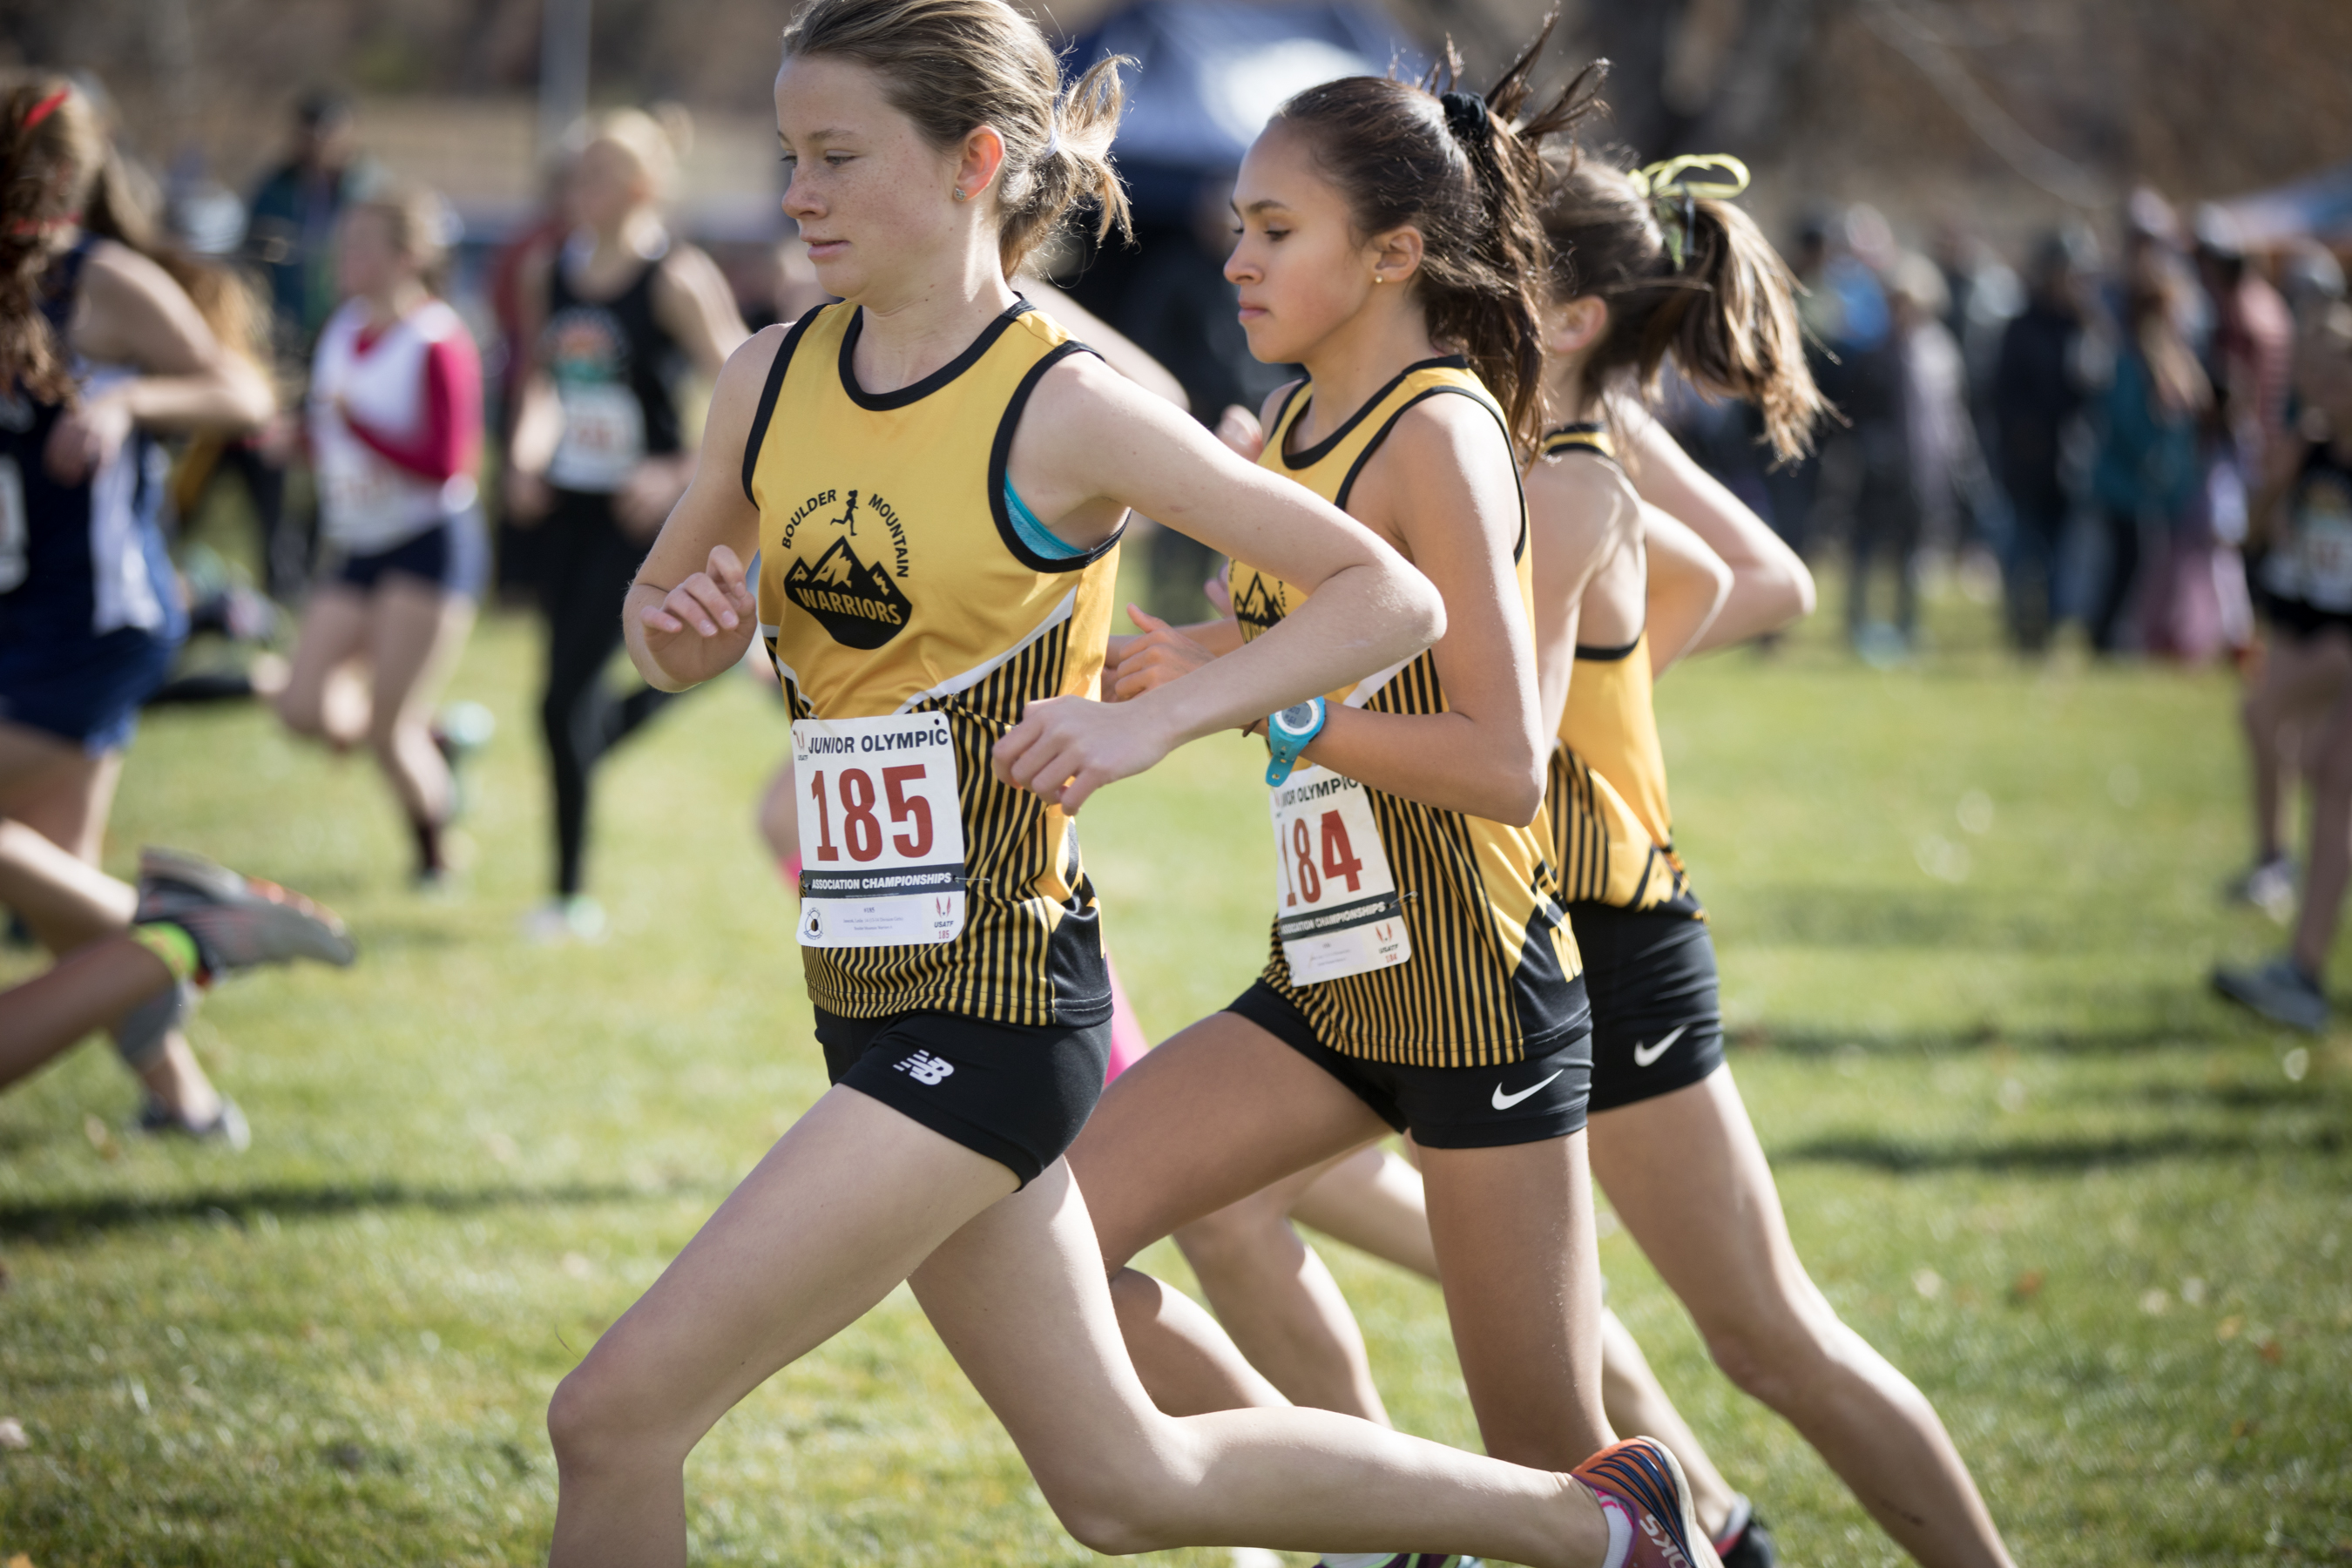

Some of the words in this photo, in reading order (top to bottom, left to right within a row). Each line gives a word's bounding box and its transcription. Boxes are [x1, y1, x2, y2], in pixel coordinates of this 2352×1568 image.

[781, 489, 837, 550] BOULDER
[868, 493, 909, 578] MOUNTAIN
[794, 587, 902, 625] WARRIORS
[808, 736, 855, 754] JUNIOR
[861, 728, 949, 753] OLYMPIC
[1297, 776, 1358, 801] OLYMPIC
[811, 763, 934, 862] 185
[1281, 809, 1363, 908] 184
[811, 878, 860, 890] ASSOCIATION
[862, 872, 952, 889] CHAMPIONSHIPS
[934, 920, 955, 929] USATF
[1315, 901, 1386, 929] CHAMPIONSHIPS
[937, 929, 950, 940] 185
[1378, 943, 1399, 954] USATF
